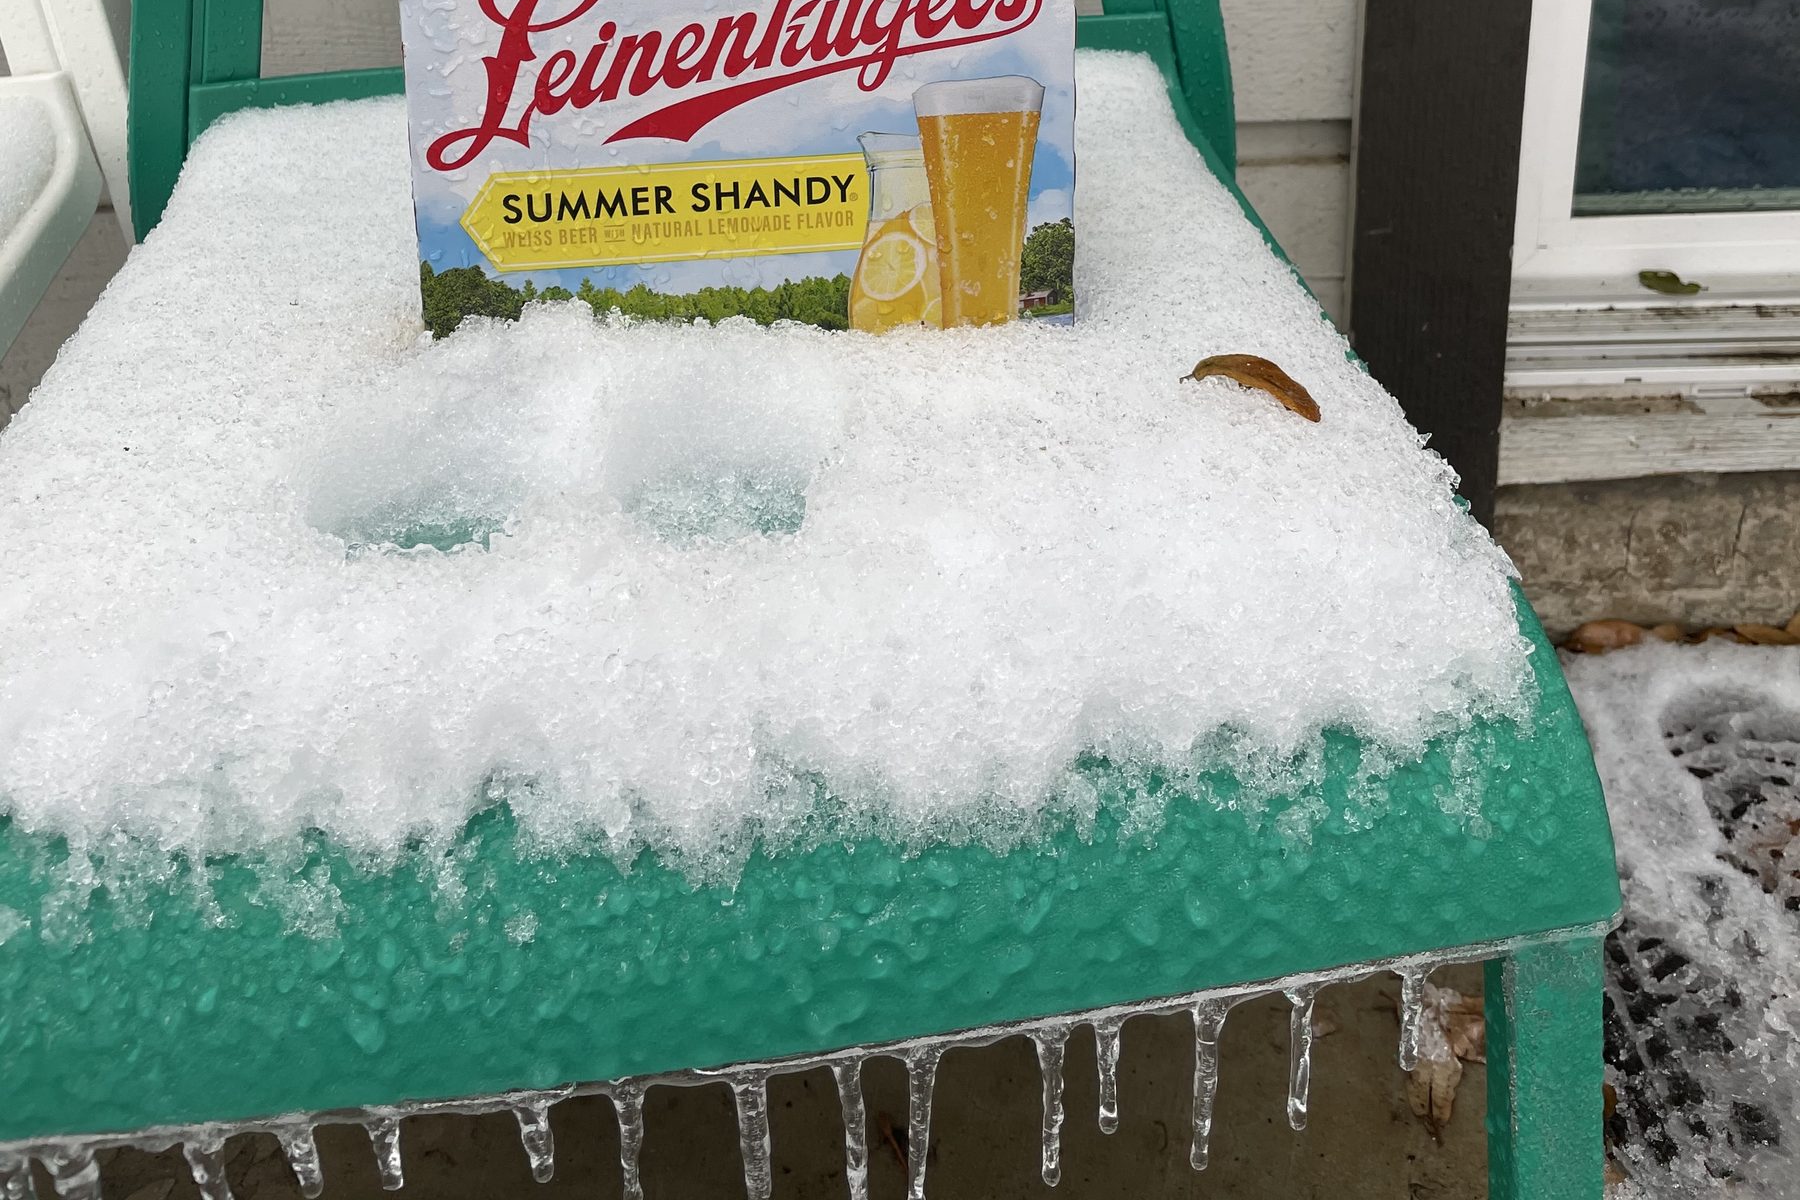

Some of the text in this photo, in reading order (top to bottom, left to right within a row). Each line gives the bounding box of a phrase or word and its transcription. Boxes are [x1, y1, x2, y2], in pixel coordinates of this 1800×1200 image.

[502, 174, 856, 224] SUMMER SHANDY
[503, 210, 854, 249] WEISS BEER WITH NATURAL LEMONADE FLAVOR
